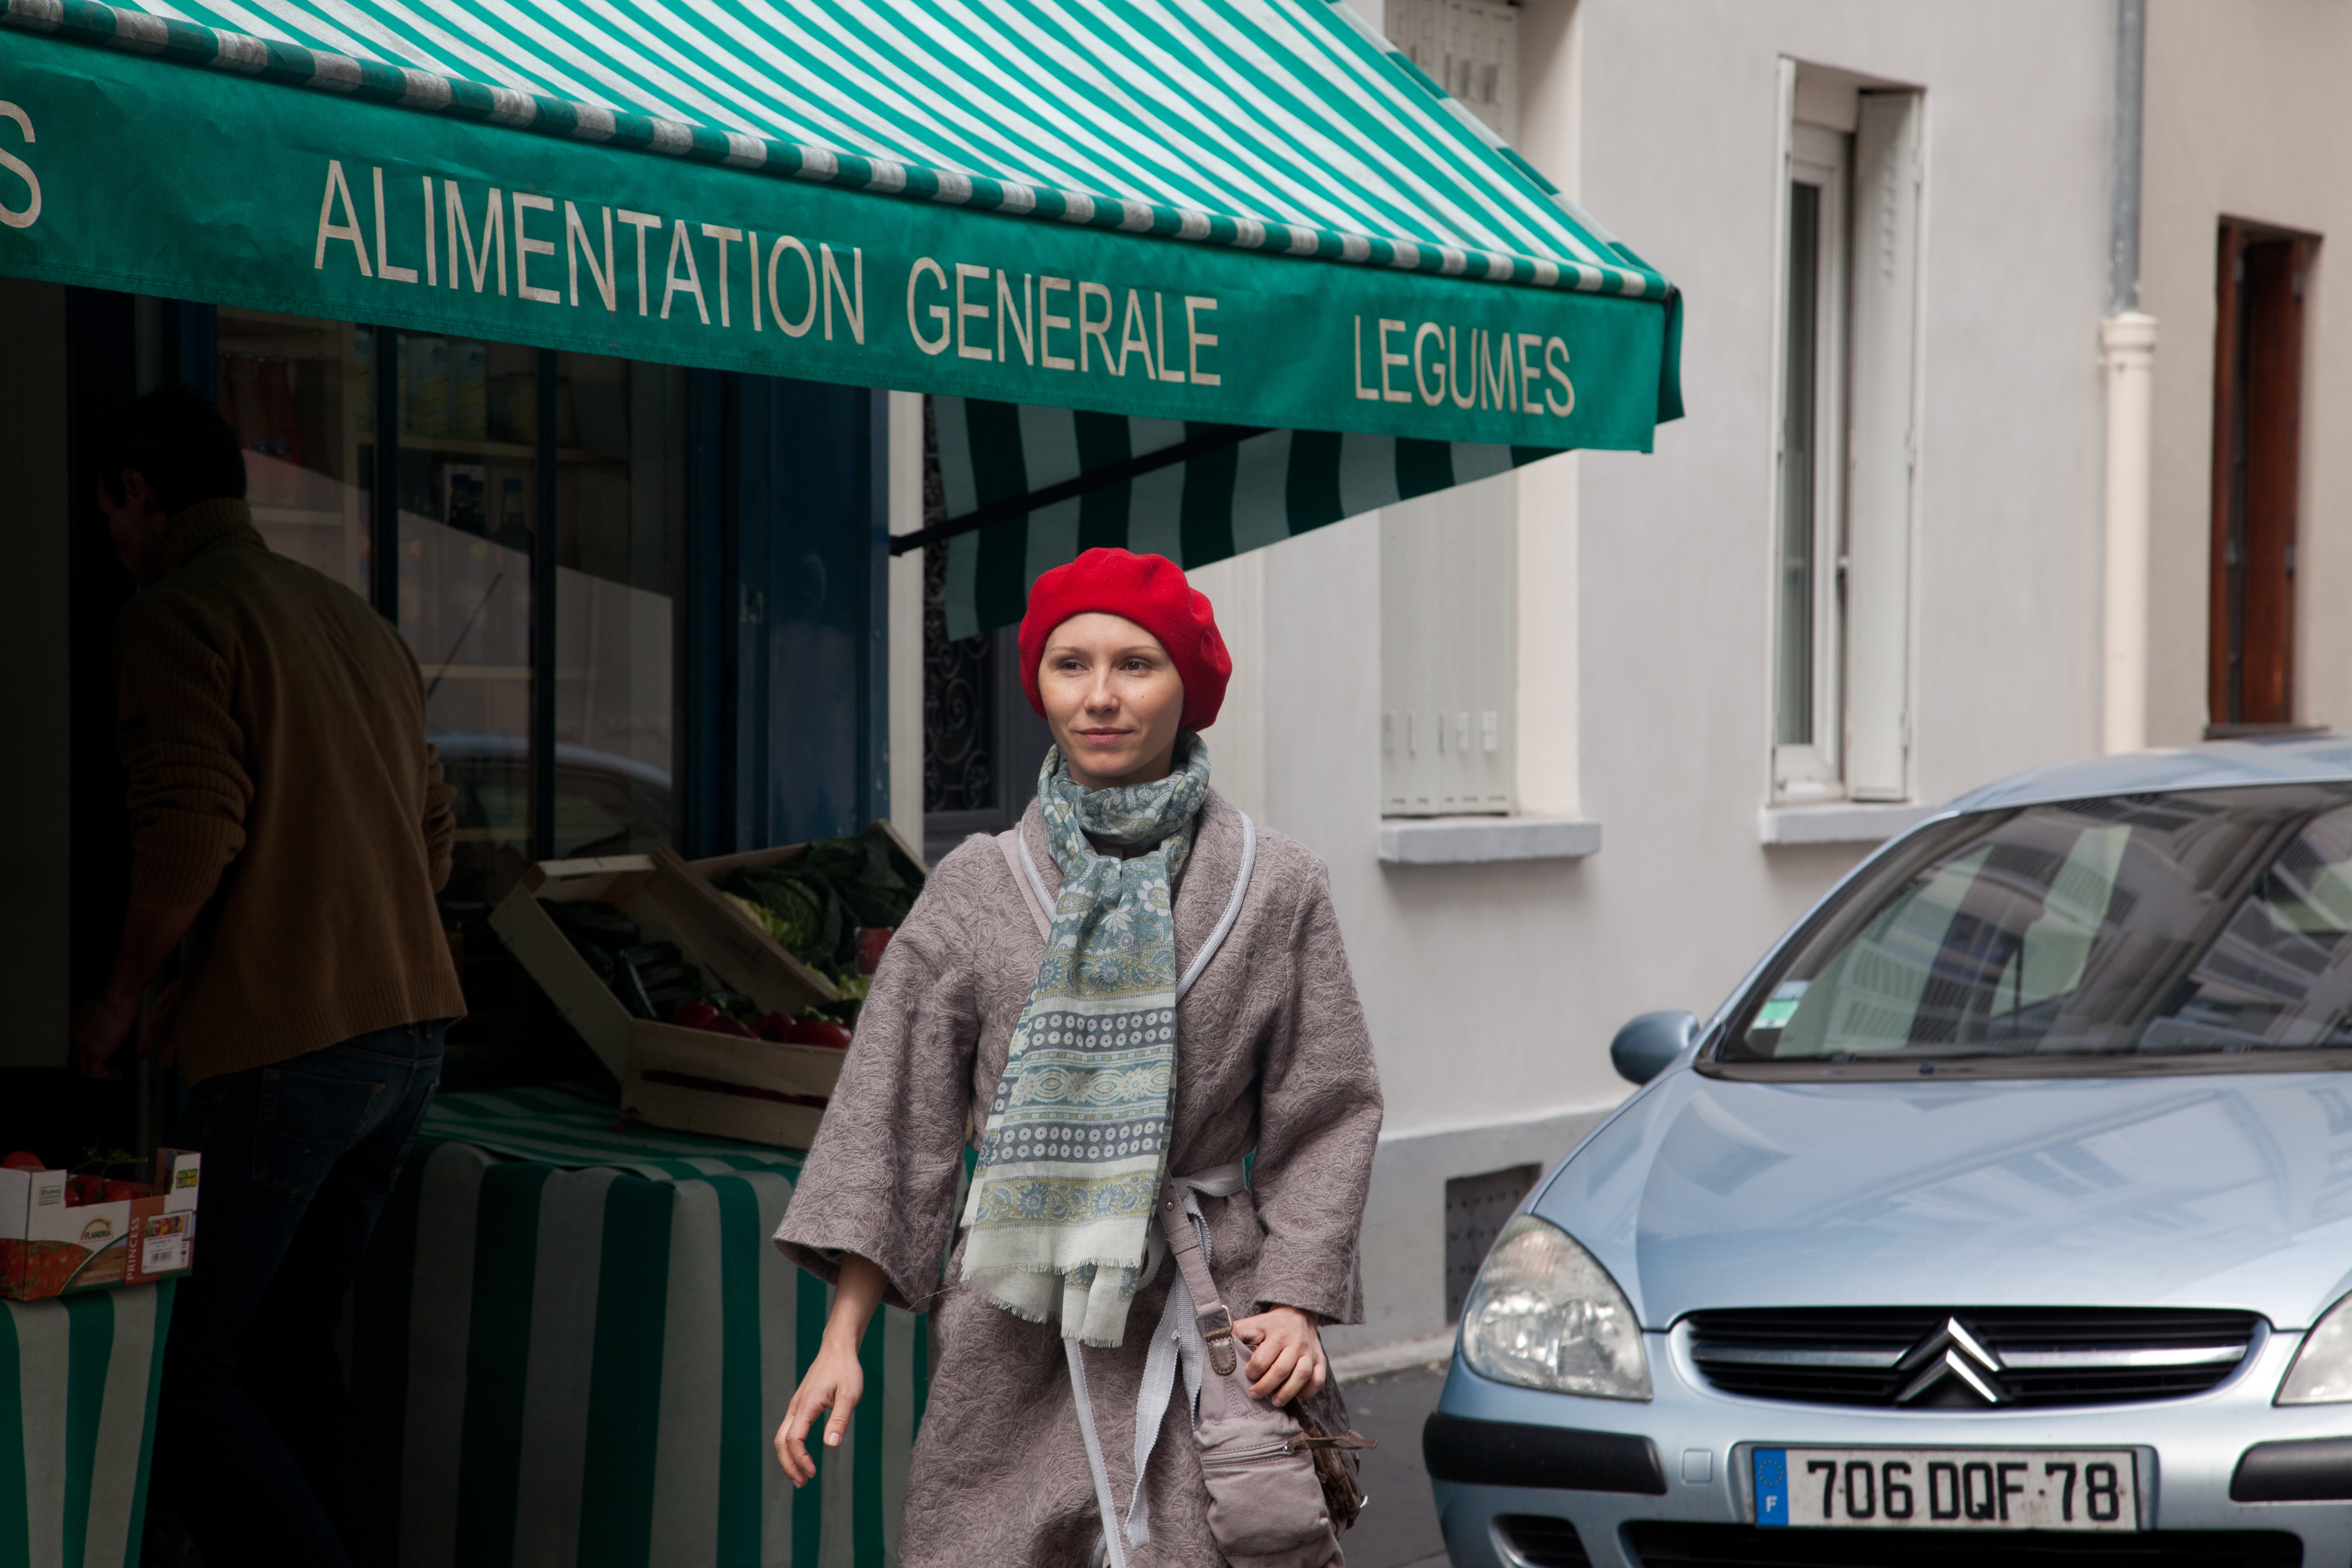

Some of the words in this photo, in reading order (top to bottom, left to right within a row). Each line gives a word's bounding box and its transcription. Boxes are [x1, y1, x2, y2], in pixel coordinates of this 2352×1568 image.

[315, 160, 865, 345] ALIMENTATION
[908, 257, 1220, 386] GENERALE
[1355, 315, 1575, 417] LEGUMES
[84, 1230, 111, 1240] FLANDRIA
[126, 1217, 140, 1280] PRINCESS
[1766, 1496, 1777, 1512] F
[1807, 1460, 1914, 1520] 706
[1929, 1462, 2027, 1522] DQF
[2045, 1462, 2119, 1522] 78
